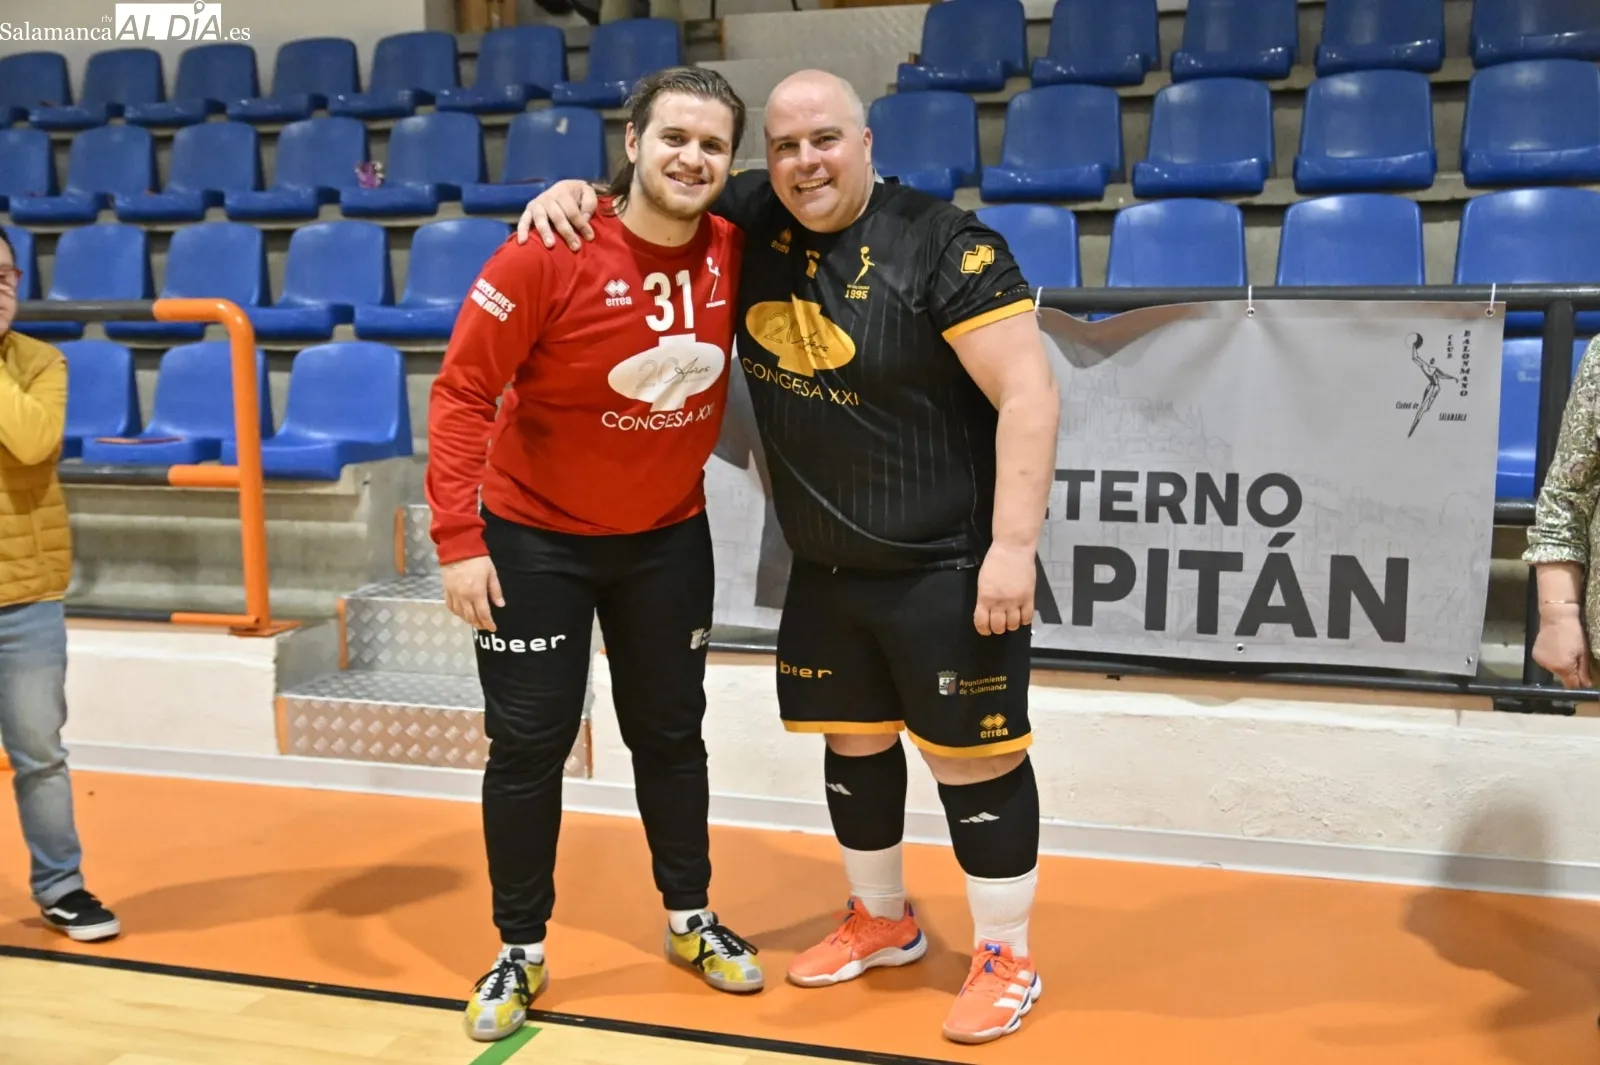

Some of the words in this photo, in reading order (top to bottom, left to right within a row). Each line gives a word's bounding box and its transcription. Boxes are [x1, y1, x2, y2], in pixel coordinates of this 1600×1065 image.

[643, 269, 694, 332] 31
[844, 290, 869, 300] 1995
[1459, 329, 1471, 397] BALONMANO
[742, 357, 824, 401] CONGESA
[828, 387, 860, 406] XXI
[601, 410, 693, 432] CONGESA
[1045, 469, 1303, 528] TERNO
[780, 660, 833, 679] beer
[959, 675, 1007, 687] Ayuntamiento
[970, 683, 1007, 696] Salamanca
